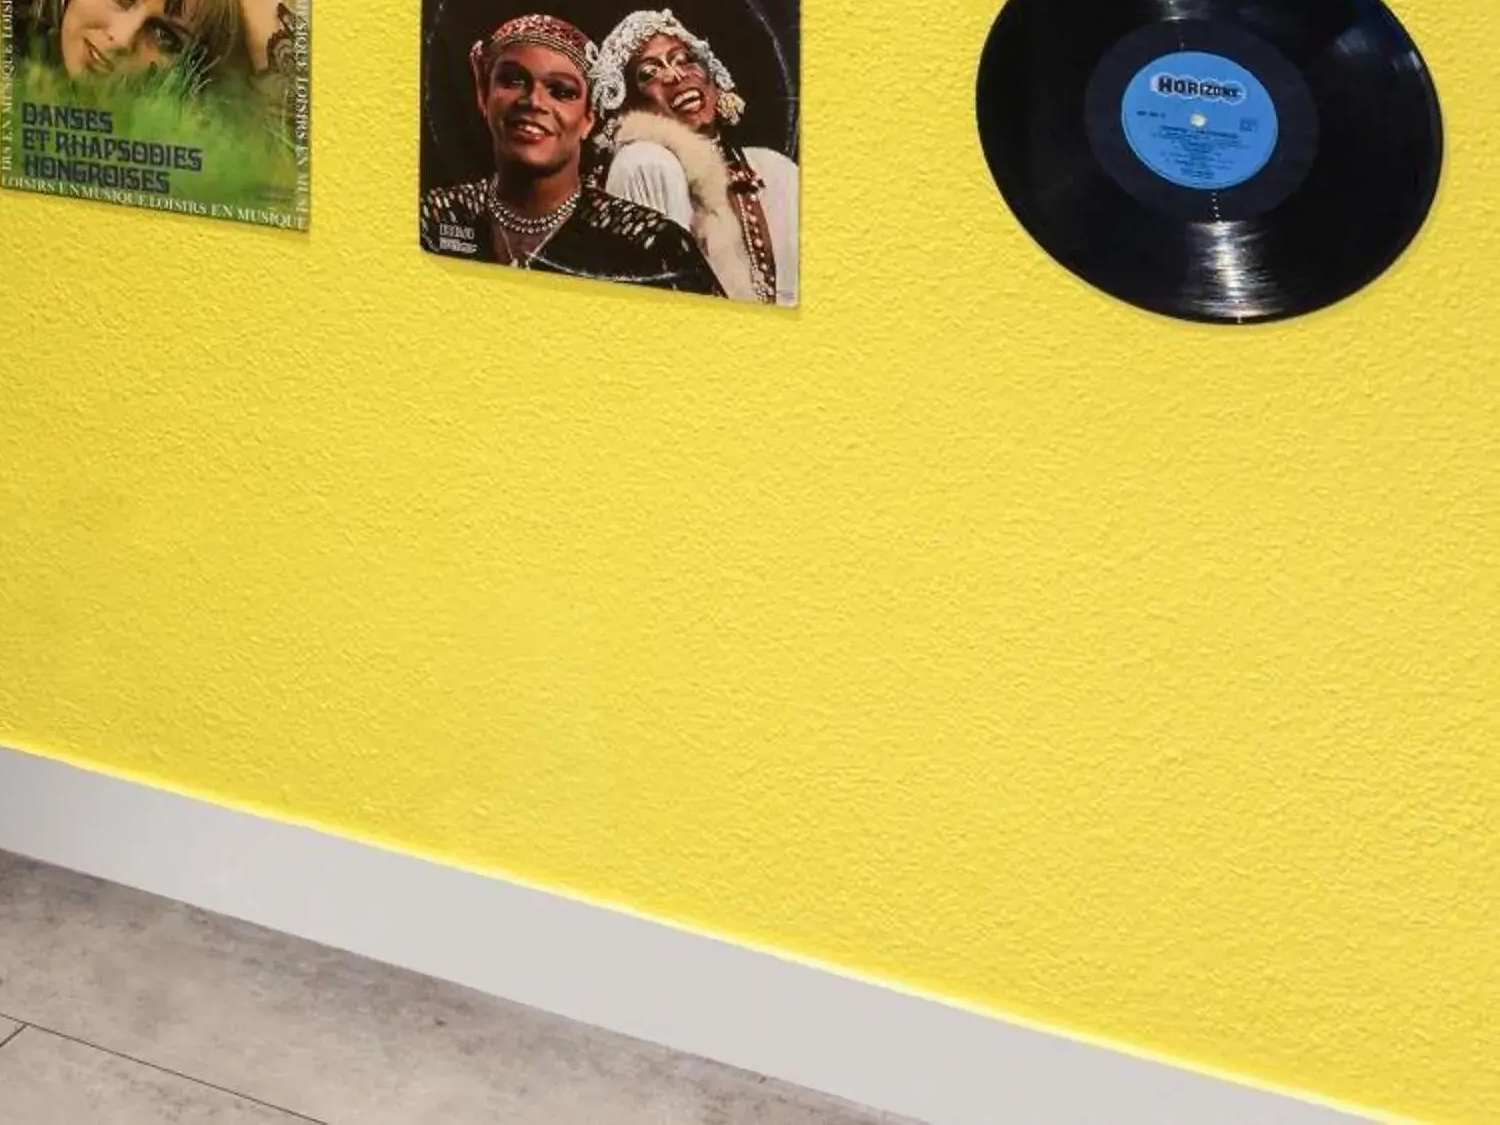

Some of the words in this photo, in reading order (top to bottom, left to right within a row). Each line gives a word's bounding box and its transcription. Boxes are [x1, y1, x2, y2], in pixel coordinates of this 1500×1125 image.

[22, 102, 113, 133] DANSES
[22, 128, 49, 151] ET
[55, 132, 203, 172] RHAPSODIES
[23, 155, 170, 194] HONGROISES
[150, 195, 206, 215] LOISIRS
[212, 202, 233, 217] EN
